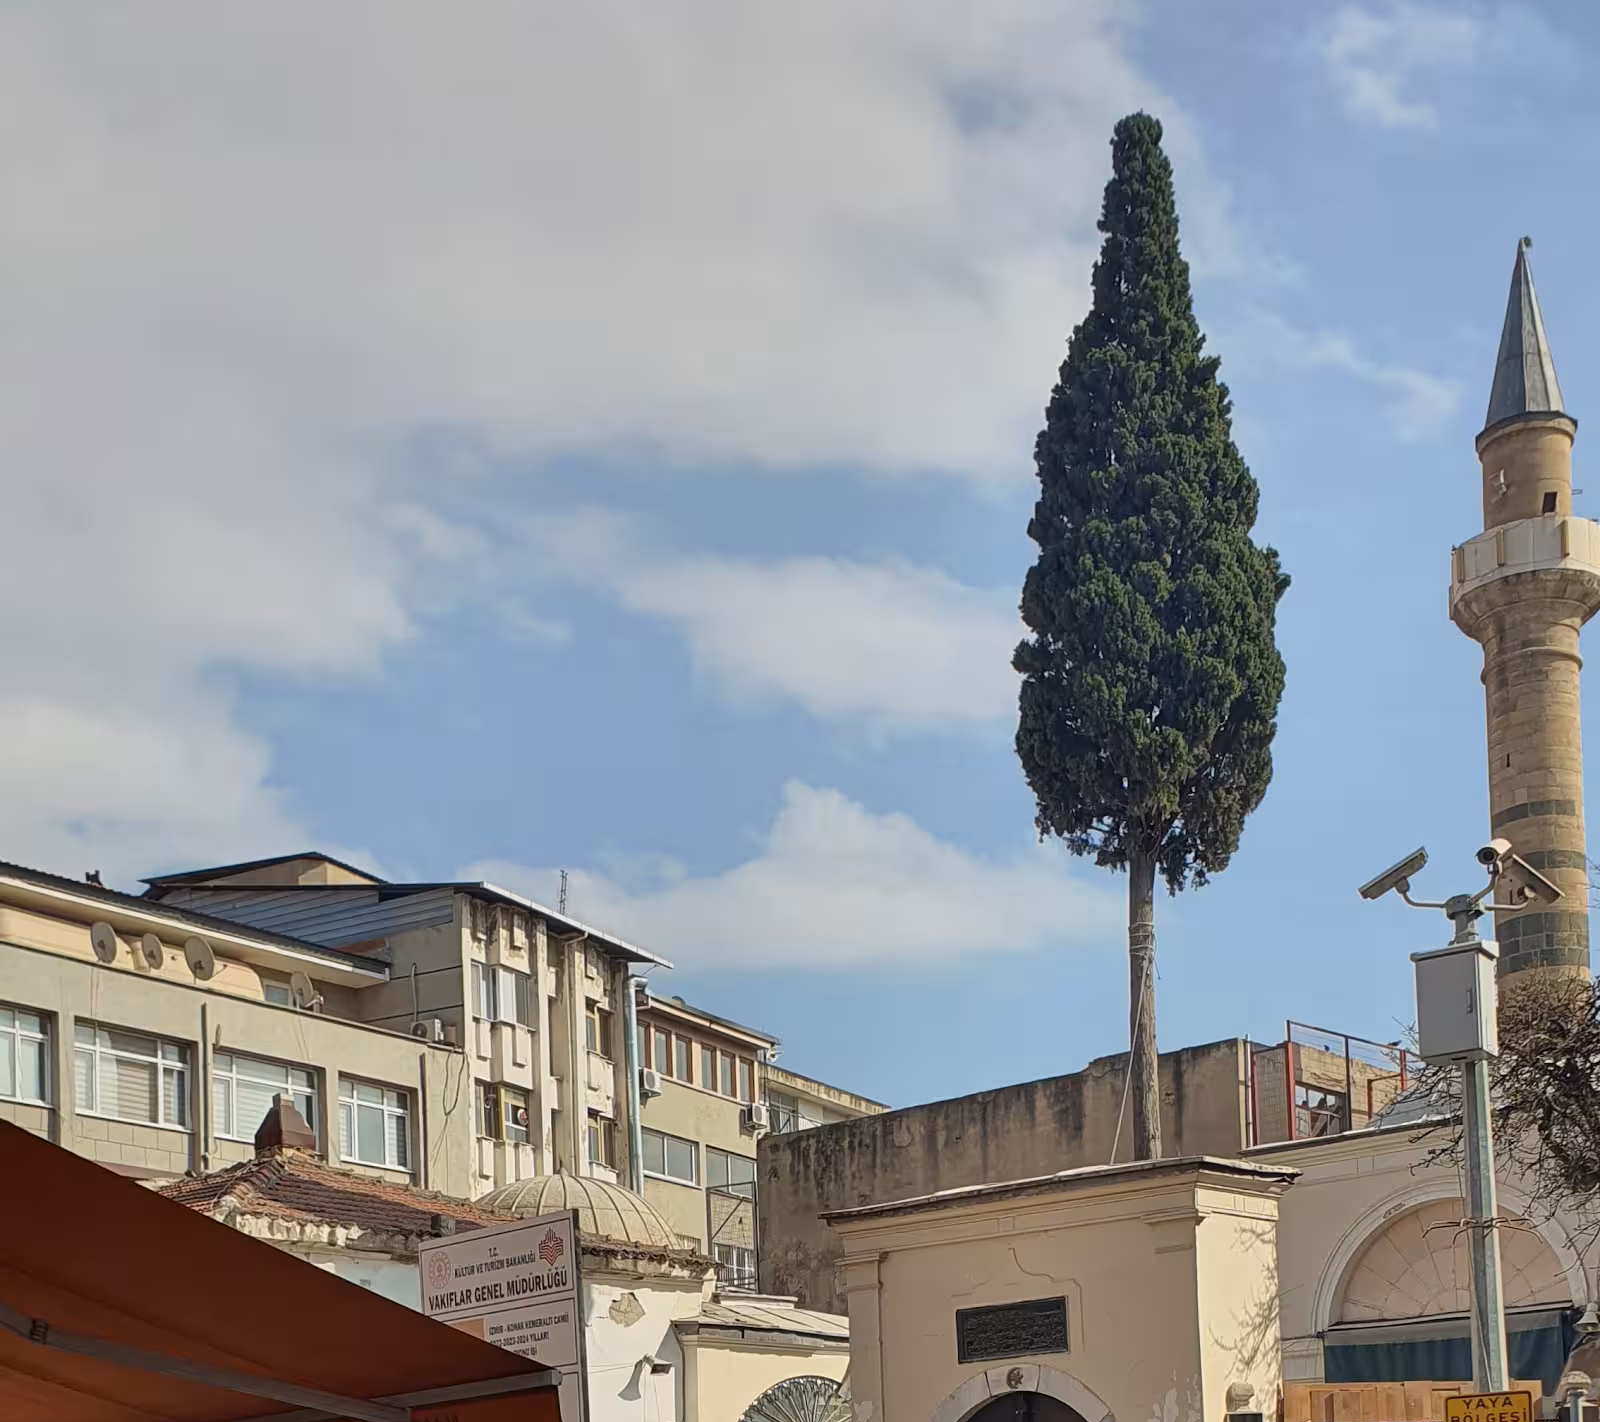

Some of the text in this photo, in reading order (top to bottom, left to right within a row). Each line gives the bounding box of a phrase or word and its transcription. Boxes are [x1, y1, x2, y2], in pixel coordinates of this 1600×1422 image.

[488, 1247, 499, 1258] T.C.
[454, 1250, 537, 1279] KÜLTÜR VE TURİZM BAKANLIĞI
[428, 1266, 568, 1311] VAKIFLAR GENEL MÜDÜRLÜĞÜ
[506, 1322, 525, 1333] KONAK
[524, 1316, 554, 1330] KEMERALTI
[529, 1330, 550, 1343] YILLARI
[1462, 1396, 1513, 1410] YAYA
